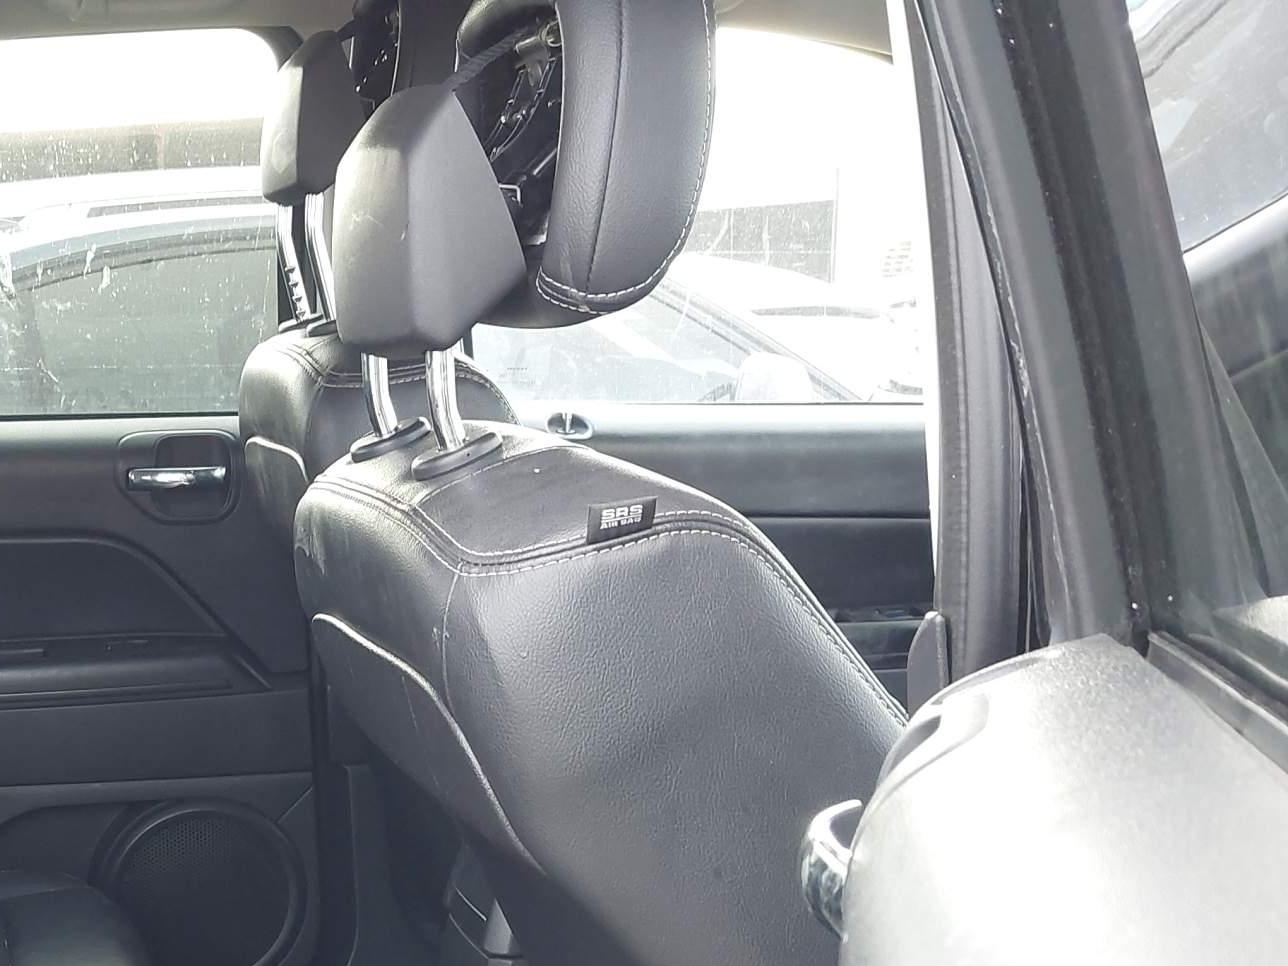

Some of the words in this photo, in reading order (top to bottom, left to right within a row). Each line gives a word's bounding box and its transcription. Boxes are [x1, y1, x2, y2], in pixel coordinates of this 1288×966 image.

[601, 504, 643, 520] SRS
[599, 520, 618, 530] AIR
[620, 517, 642, 526] BAG
